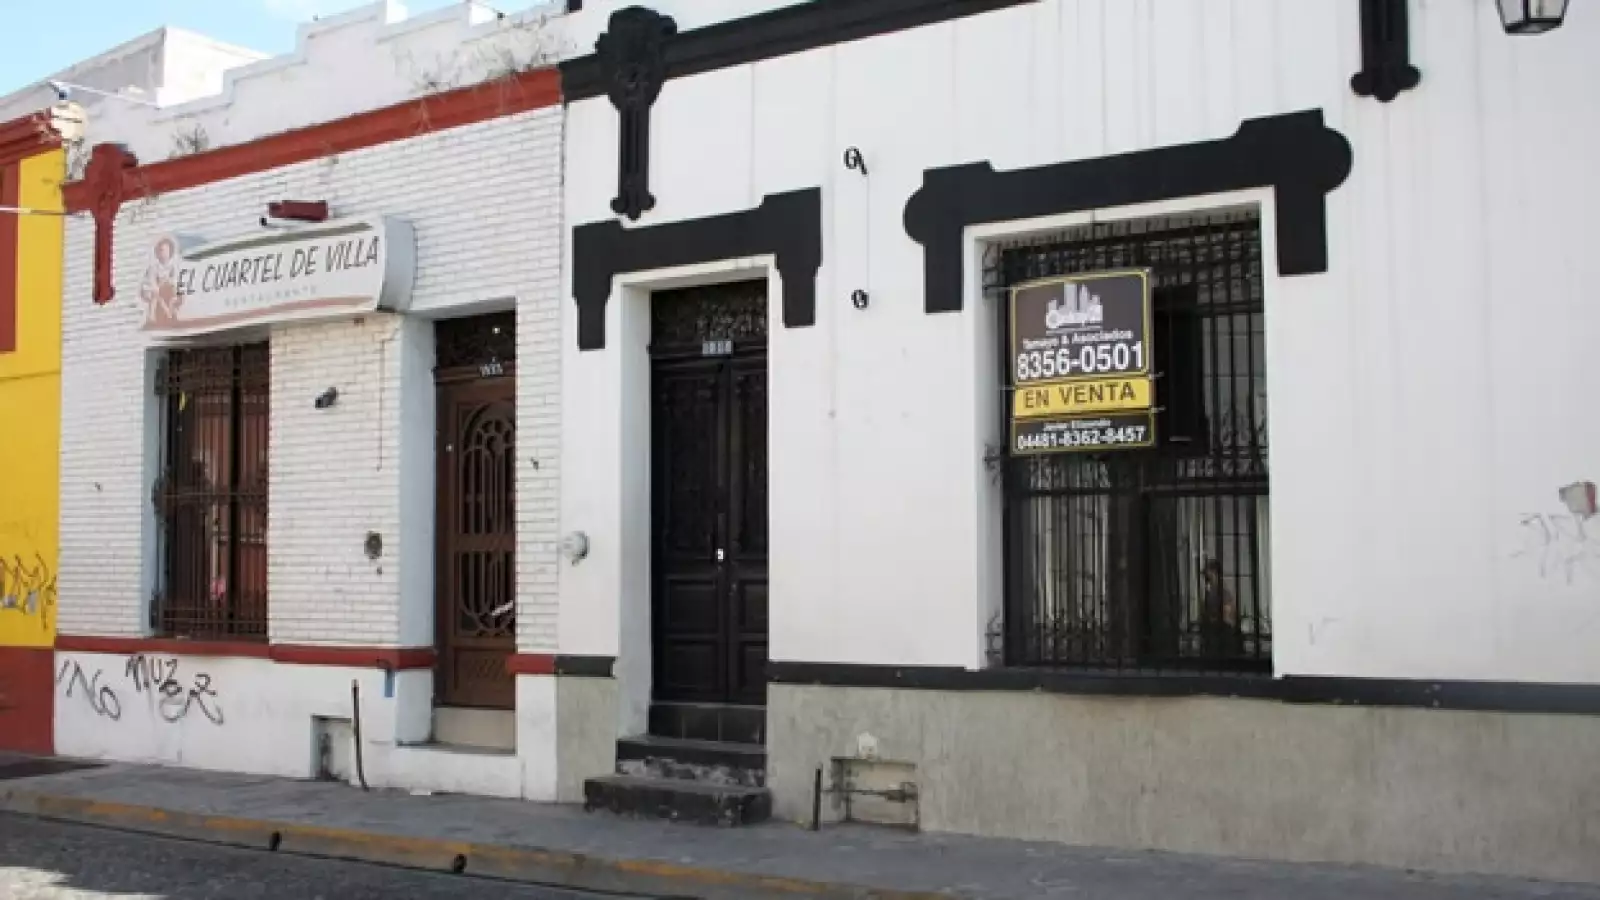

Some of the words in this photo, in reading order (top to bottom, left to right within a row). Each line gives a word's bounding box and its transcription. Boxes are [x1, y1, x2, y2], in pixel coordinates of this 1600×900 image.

[175, 268, 195, 296] EL
[202, 250, 284, 293] CUARTEL
[289, 245, 319, 279] DE
[324, 235, 380, 274] VILLA
[1017, 341, 1142, 380] 8356-0501
[1024, 388, 1049, 409] EN
[1058, 381, 1136, 406] VENTA
